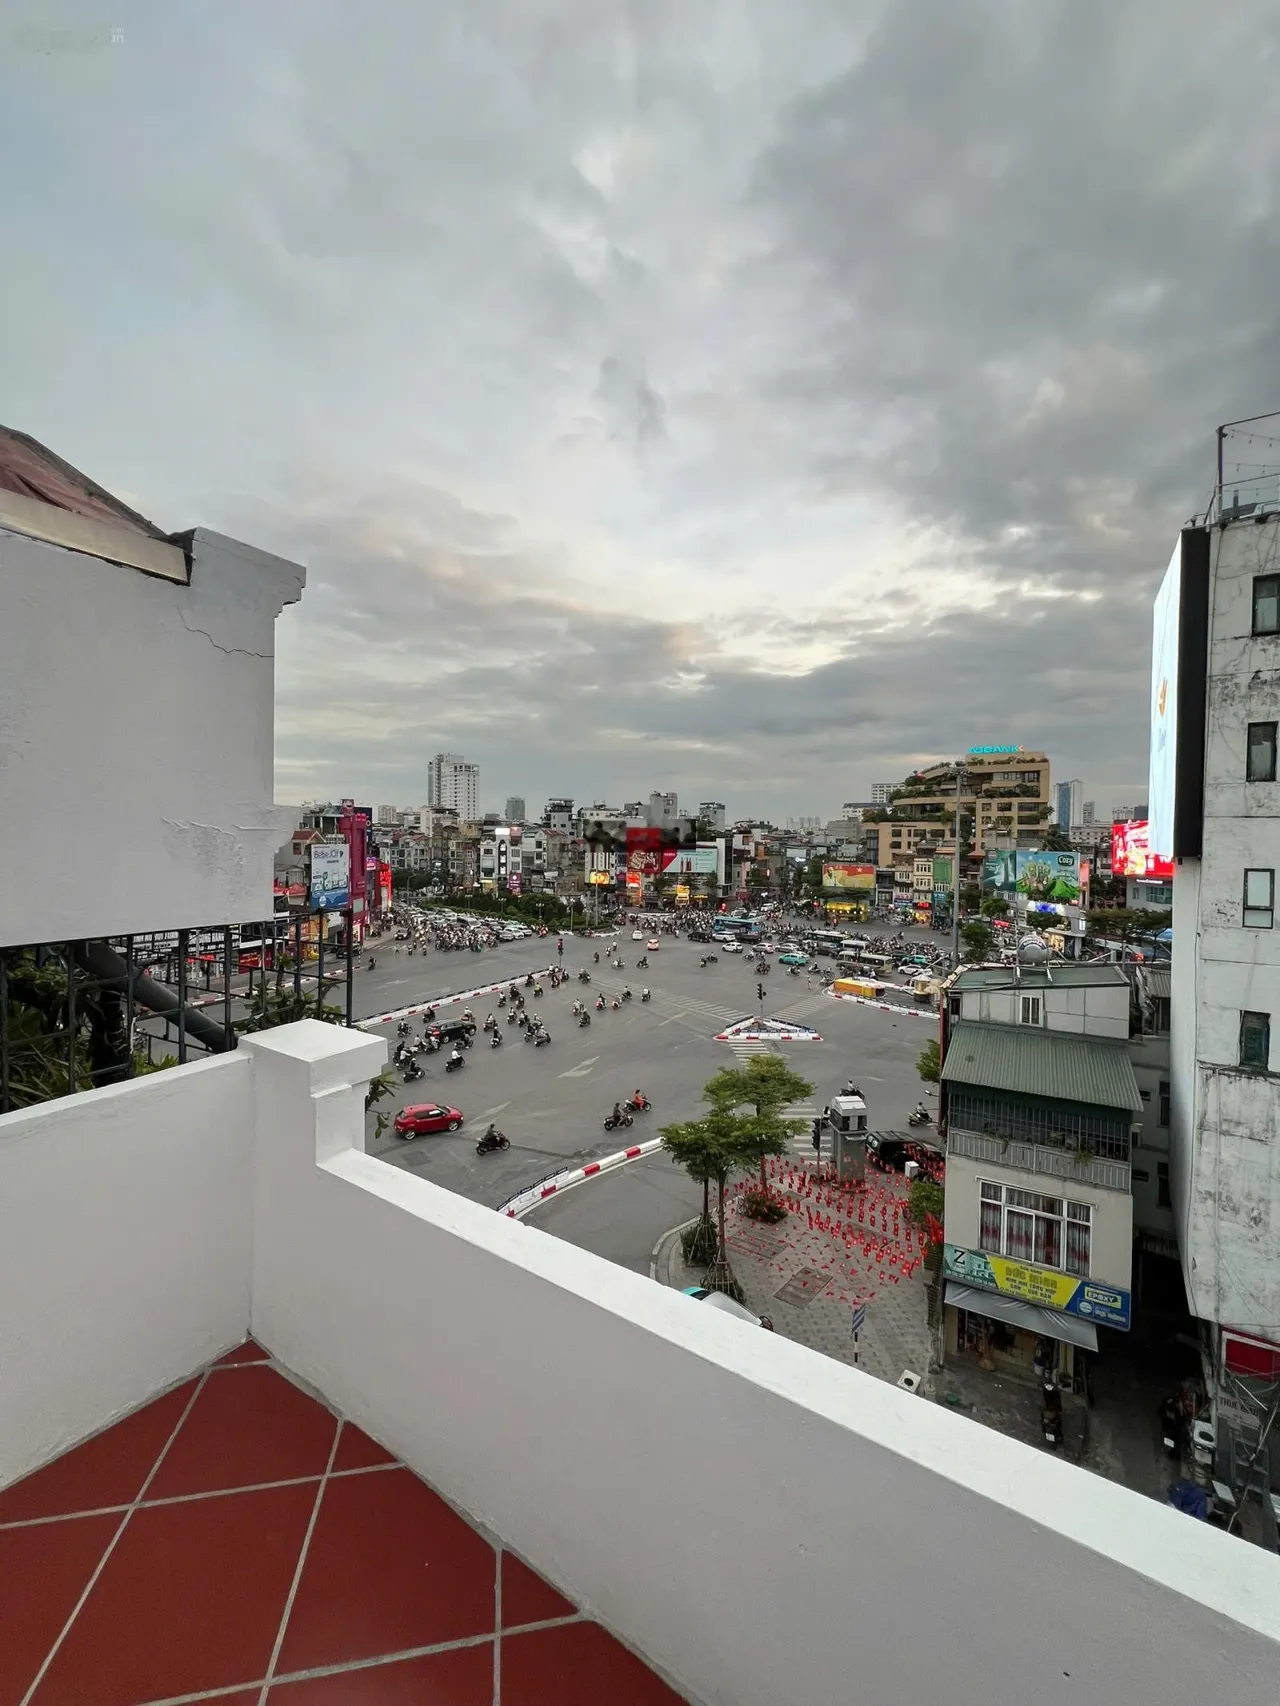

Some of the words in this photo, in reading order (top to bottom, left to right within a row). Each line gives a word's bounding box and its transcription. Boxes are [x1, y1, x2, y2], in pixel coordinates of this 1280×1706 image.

[1058, 856, 1074, 866] Cozy
[953, 1249, 966, 1265] Z
[1087, 1290, 1115, 1303] EPOXY
